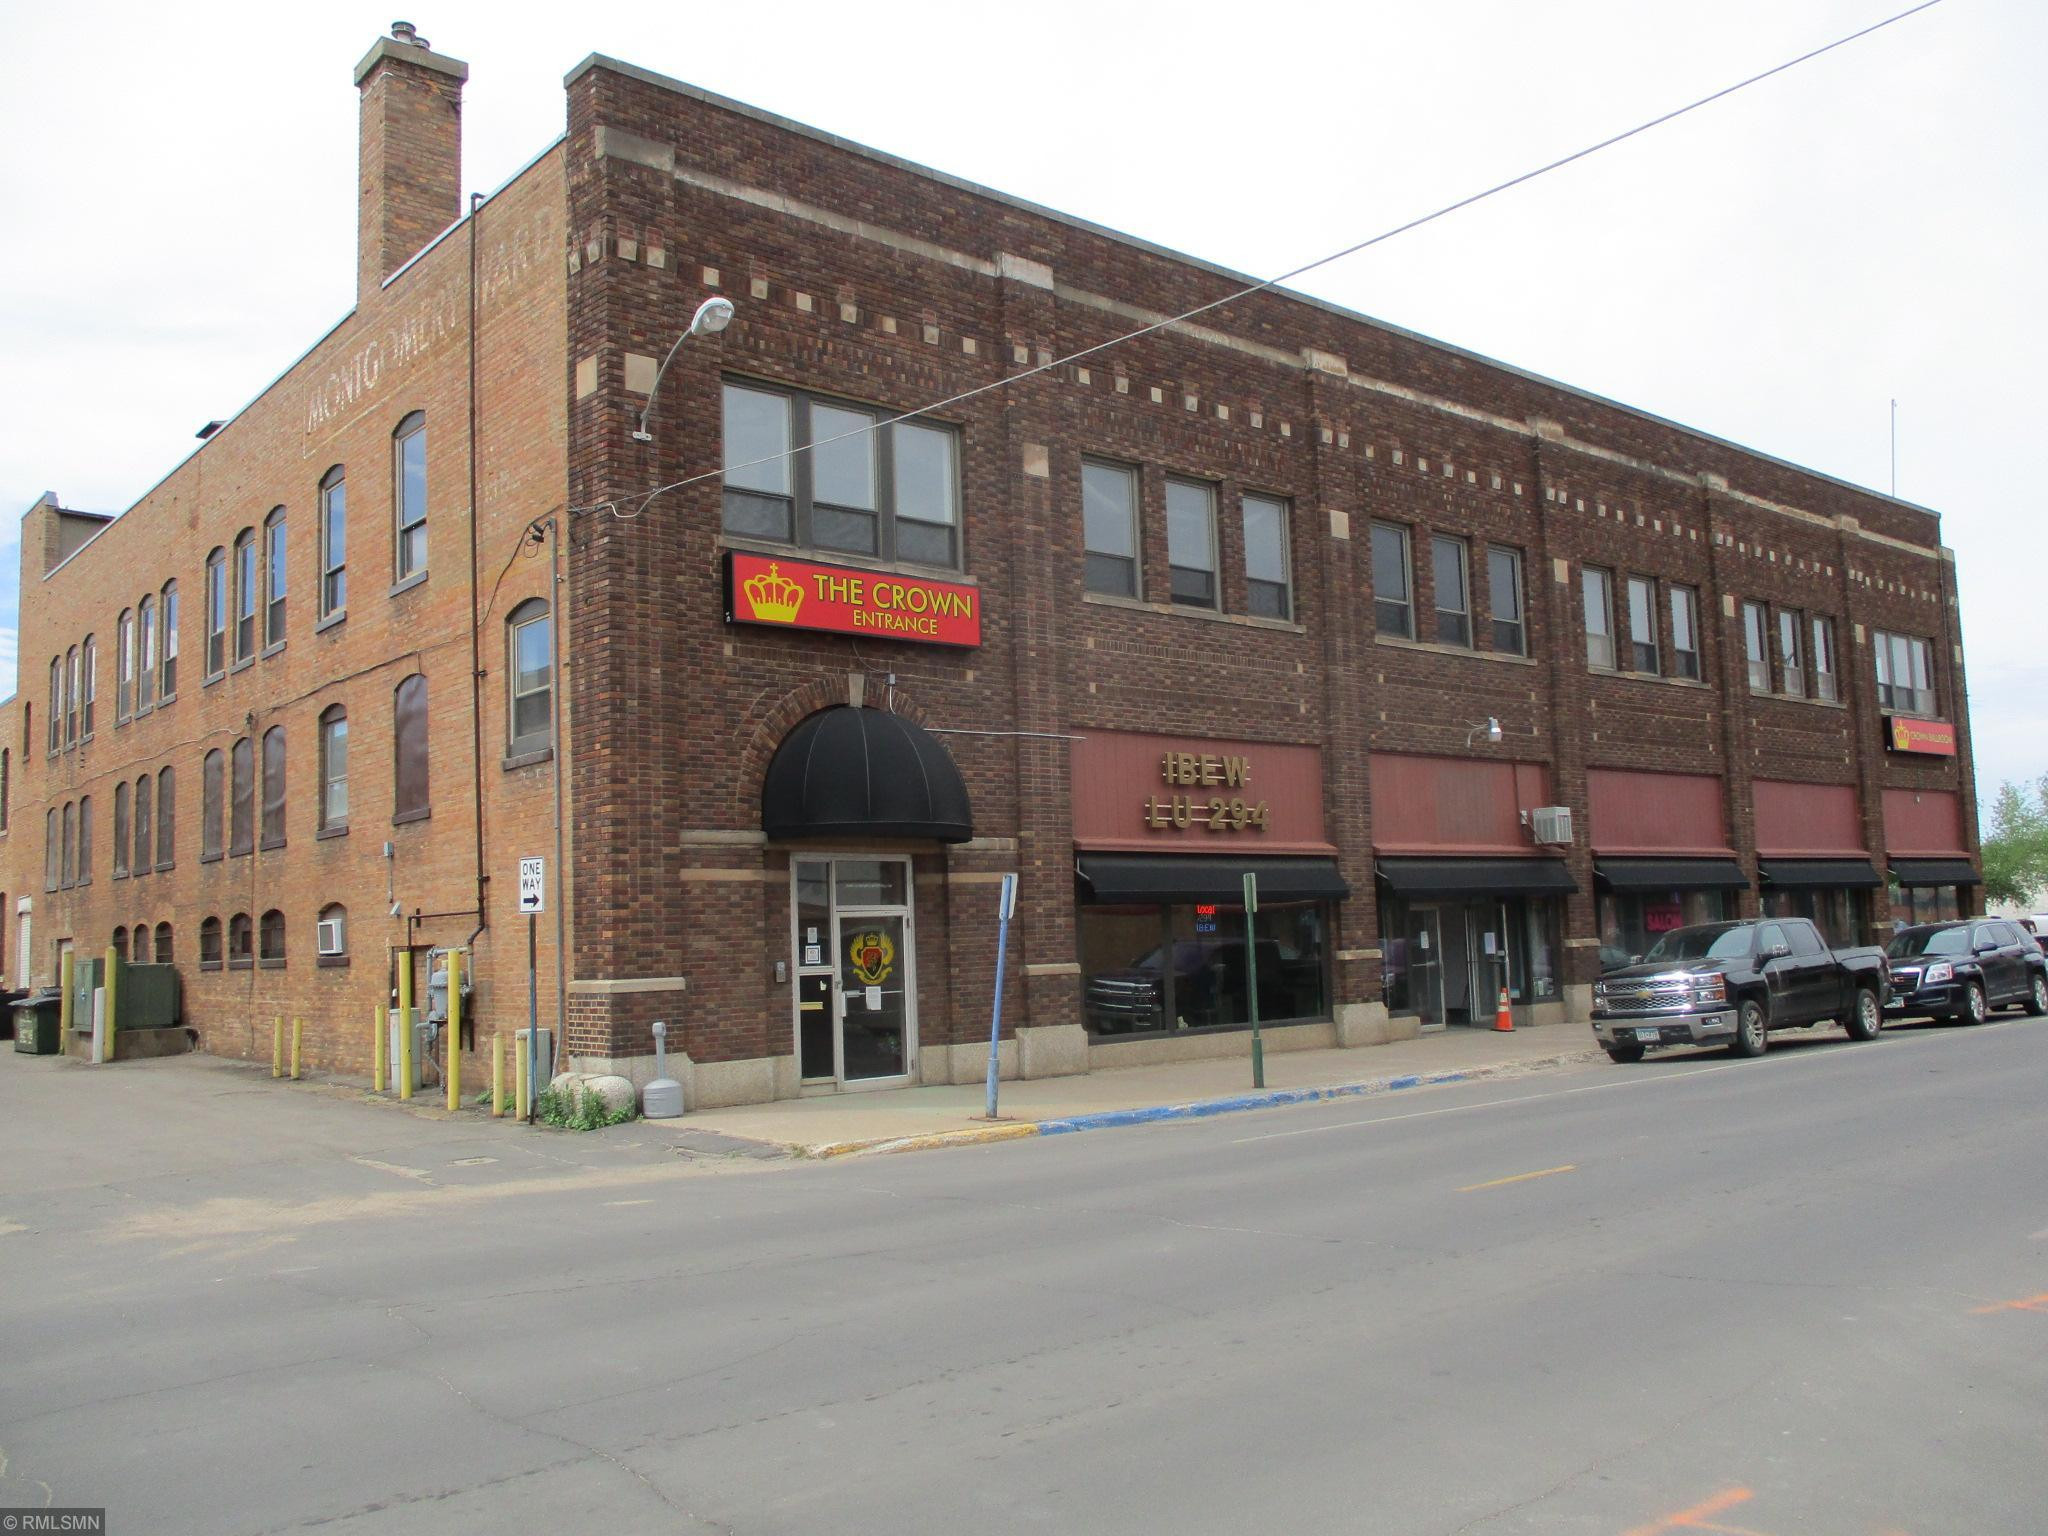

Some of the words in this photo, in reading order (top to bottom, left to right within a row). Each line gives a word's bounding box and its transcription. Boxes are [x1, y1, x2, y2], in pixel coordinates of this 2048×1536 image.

[813, 574, 864, 605] THE
[872, 583, 972, 618] CROWN
[853, 610, 938, 635] ENTRANCE
[1165, 752, 1248, 788] IBEW
[1150, 795, 1192, 829] LU
[1208, 797, 1269, 832] 294
[523, 862, 540, 875] ONE
[523, 878, 541, 890] WAY
[1197, 905, 1215, 914] Local
[1196, 923, 1216, 932] IBEW
